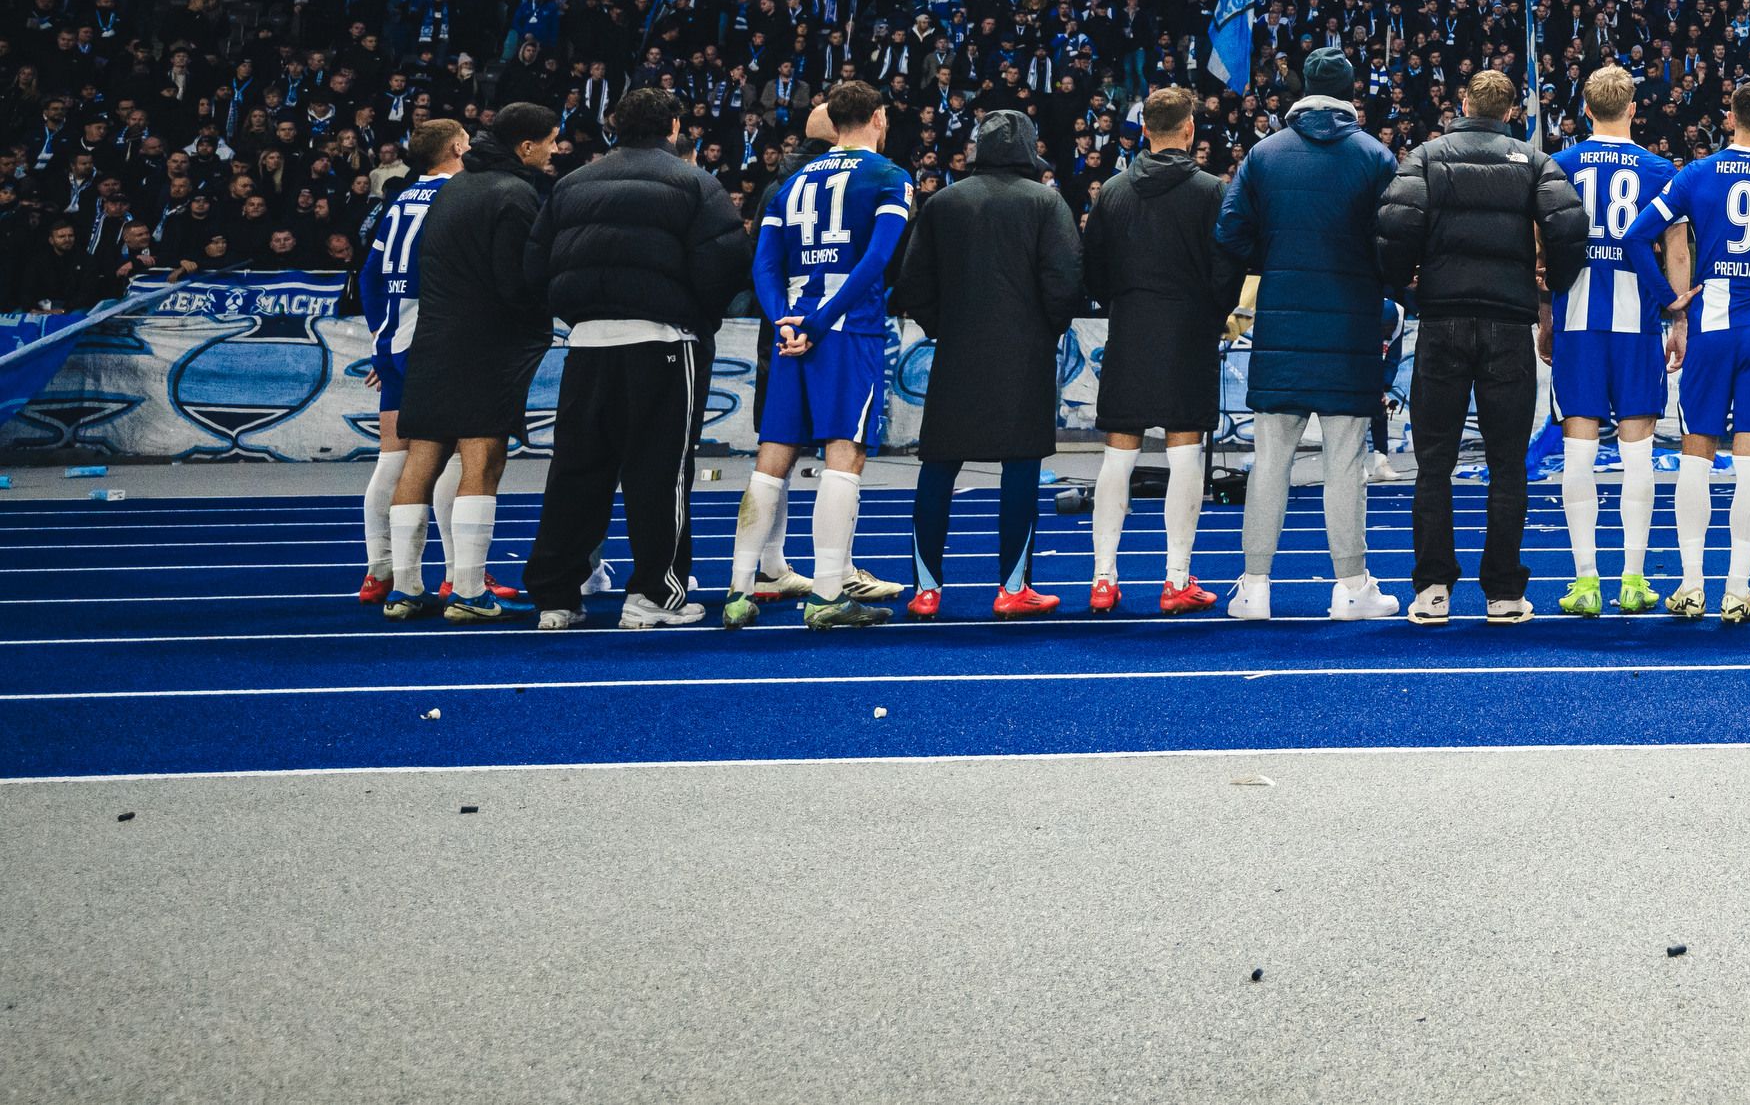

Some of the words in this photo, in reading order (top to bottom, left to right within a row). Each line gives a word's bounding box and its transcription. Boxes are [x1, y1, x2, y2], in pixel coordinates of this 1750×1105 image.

[803, 158, 840, 173] HERTHA
[841, 158, 862, 170] BSC
[1580, 152, 1619, 164] HERTHA
[1621, 153, 1640, 167] BSC
[419, 189, 437, 201] BSC
[1573, 166, 1641, 240] 18
[786, 171, 850, 246] 41
[801, 248, 839, 265] KLEMENS
[257, 293, 339, 316] MACHT
